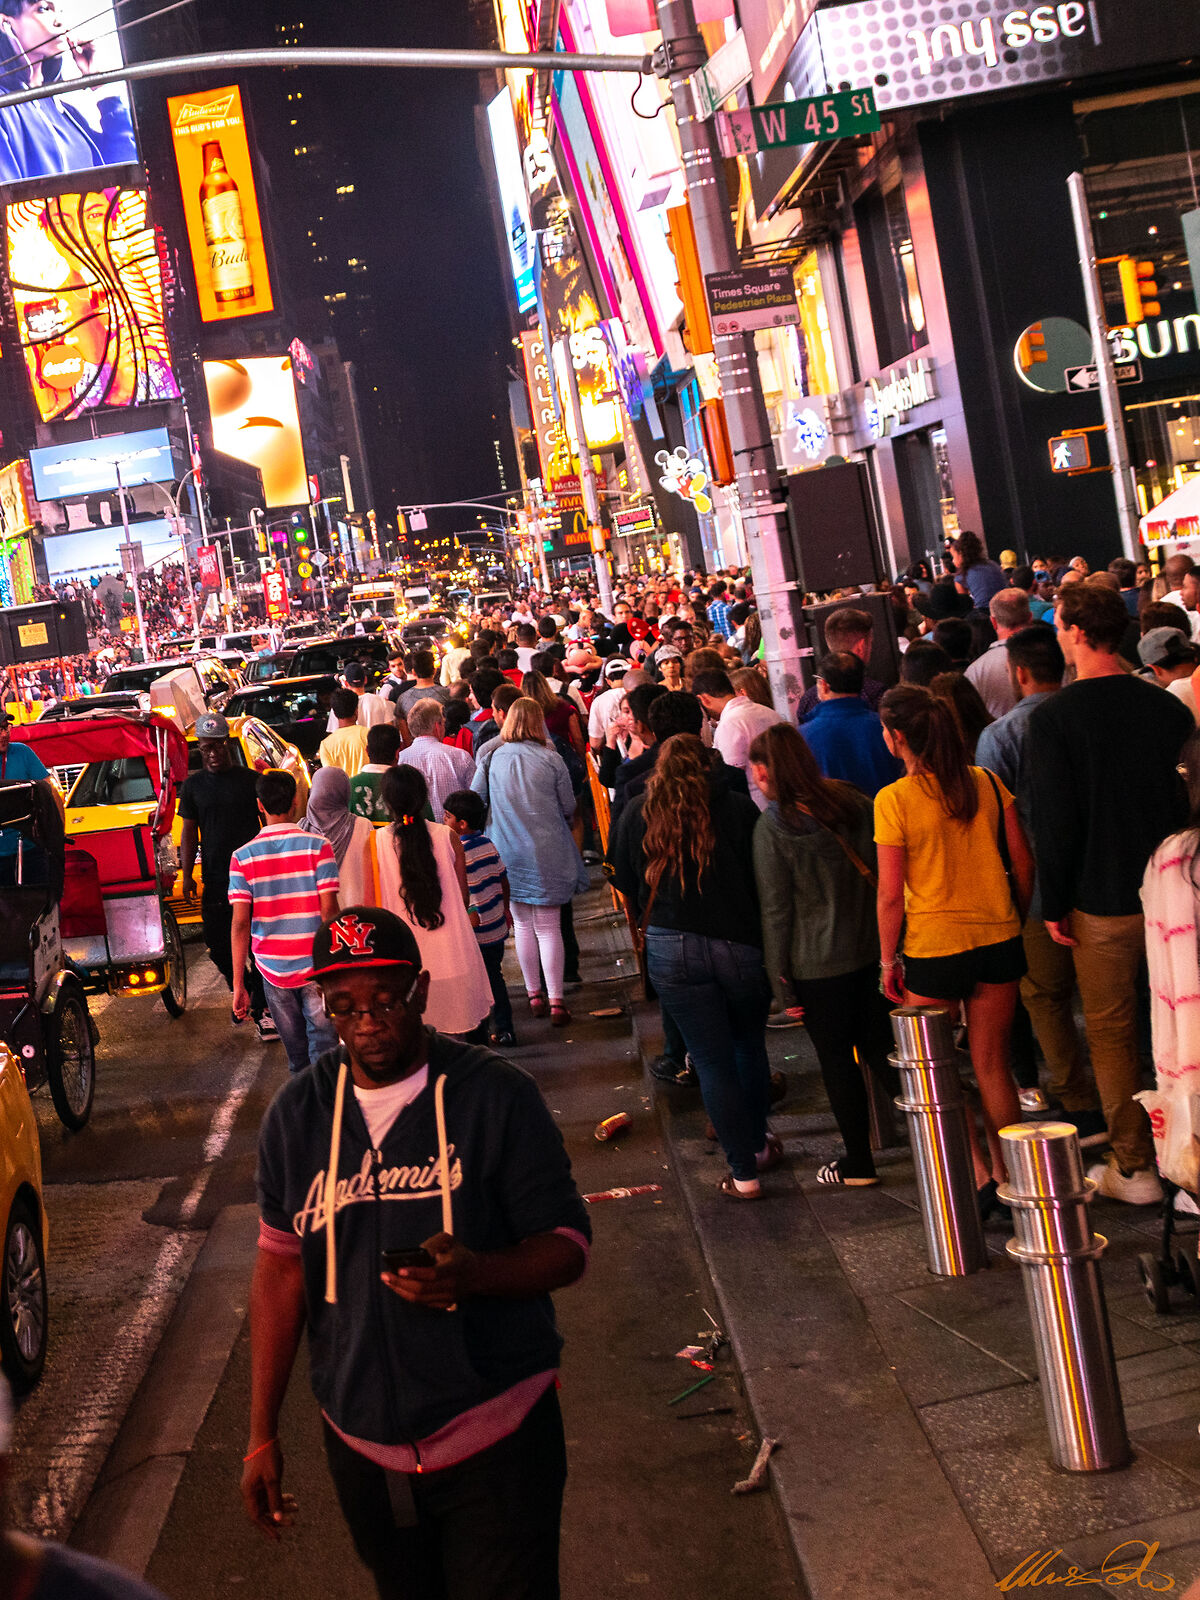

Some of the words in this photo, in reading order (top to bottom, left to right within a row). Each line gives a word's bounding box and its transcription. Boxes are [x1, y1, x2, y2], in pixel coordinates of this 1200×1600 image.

[906, 16, 999, 76] hut
[760, 108, 787, 144] W
[804, 100, 839, 136] 45
[851, 93, 872, 117] St
[712, 287, 743, 299] Times
[744, 282, 781, 295] Square
[714, 297, 766, 311] Pedestrian
[766, 294, 793, 304] Plaza
[266, 572, 284, 602] tkts
[328, 914, 376, 956] NY
